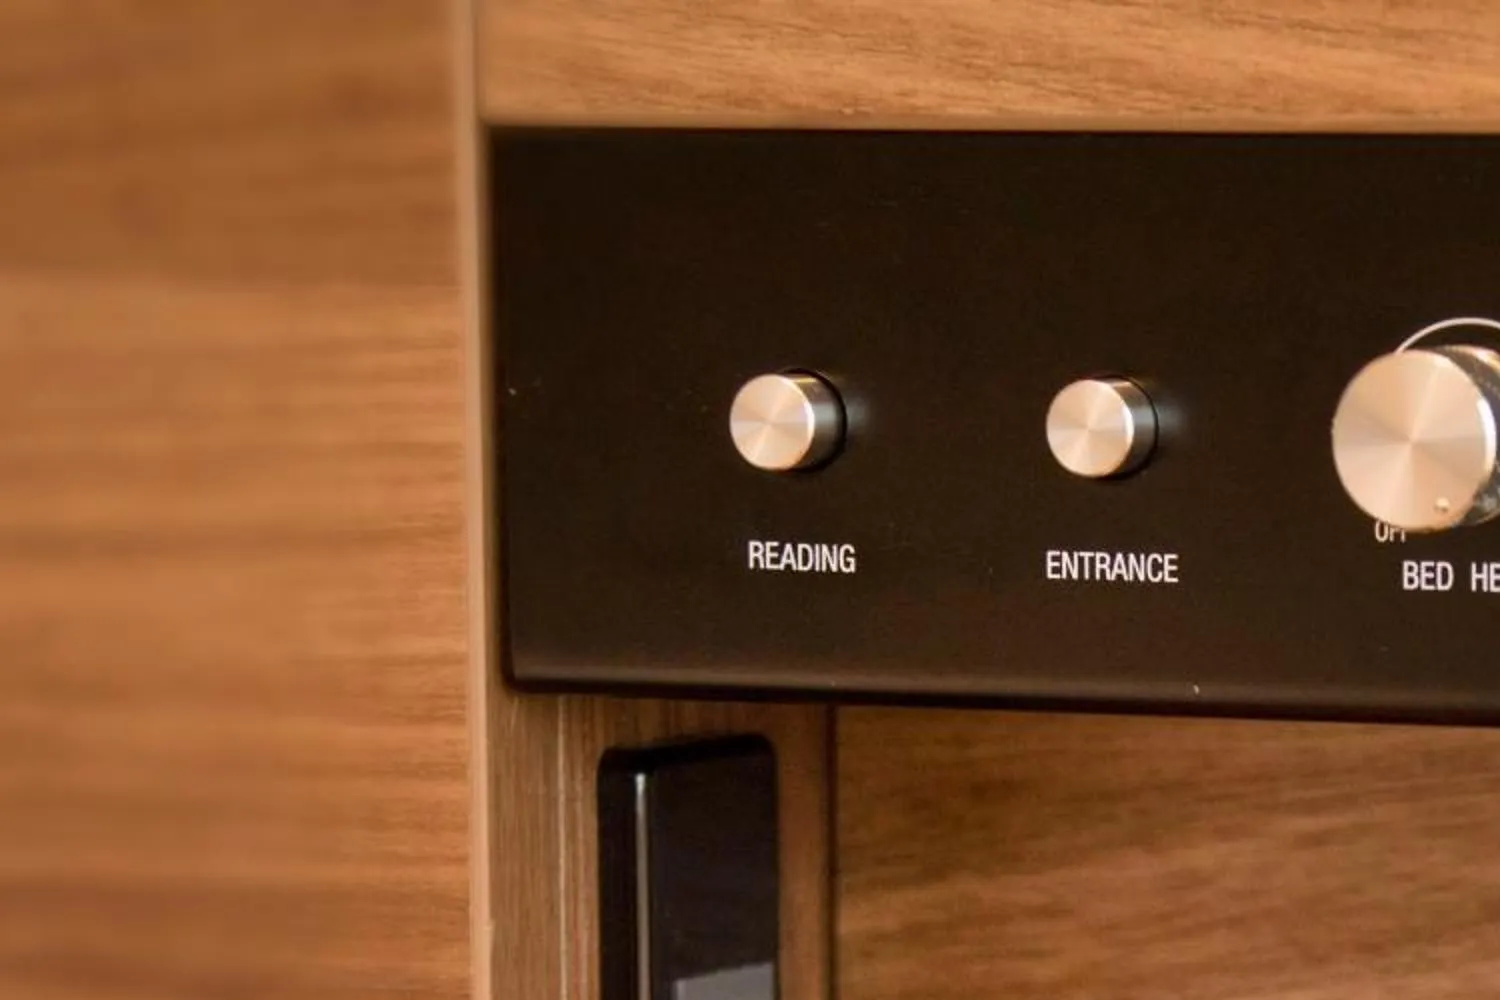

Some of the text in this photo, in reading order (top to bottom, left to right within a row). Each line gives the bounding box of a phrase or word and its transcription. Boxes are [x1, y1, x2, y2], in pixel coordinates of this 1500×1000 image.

[748, 540, 856, 573] READING
[1046, 550, 1179, 583] ENTRANCE
[1402, 560, 1455, 591] BED
